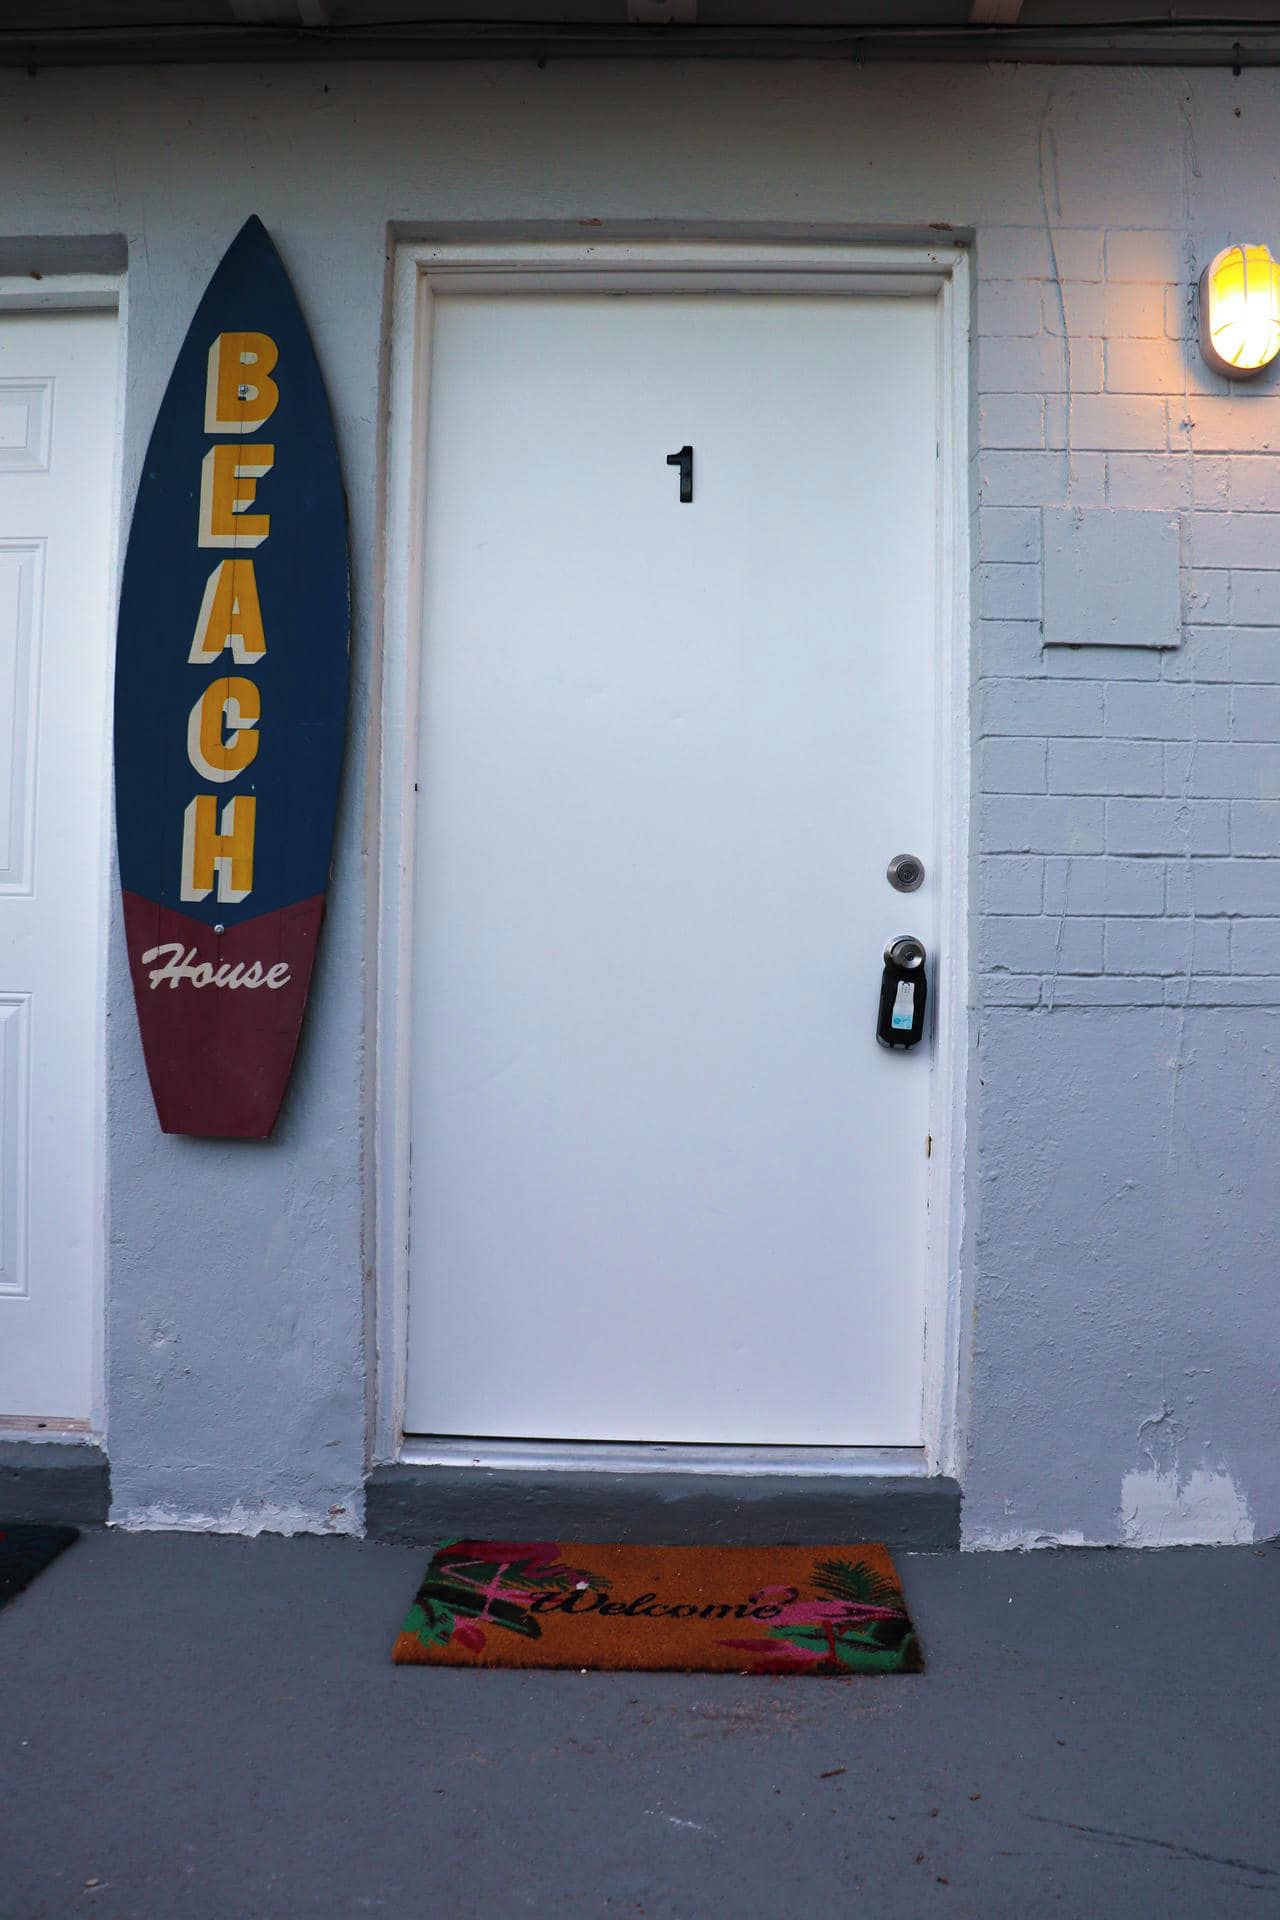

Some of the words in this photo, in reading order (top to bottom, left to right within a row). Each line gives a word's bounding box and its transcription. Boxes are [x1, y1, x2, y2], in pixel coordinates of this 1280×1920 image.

[667, 445, 693, 503] 1
[179, 332, 280, 904] BEACH
[141, 942, 291, 990] House
[529, 1589, 783, 1620] Welcome
